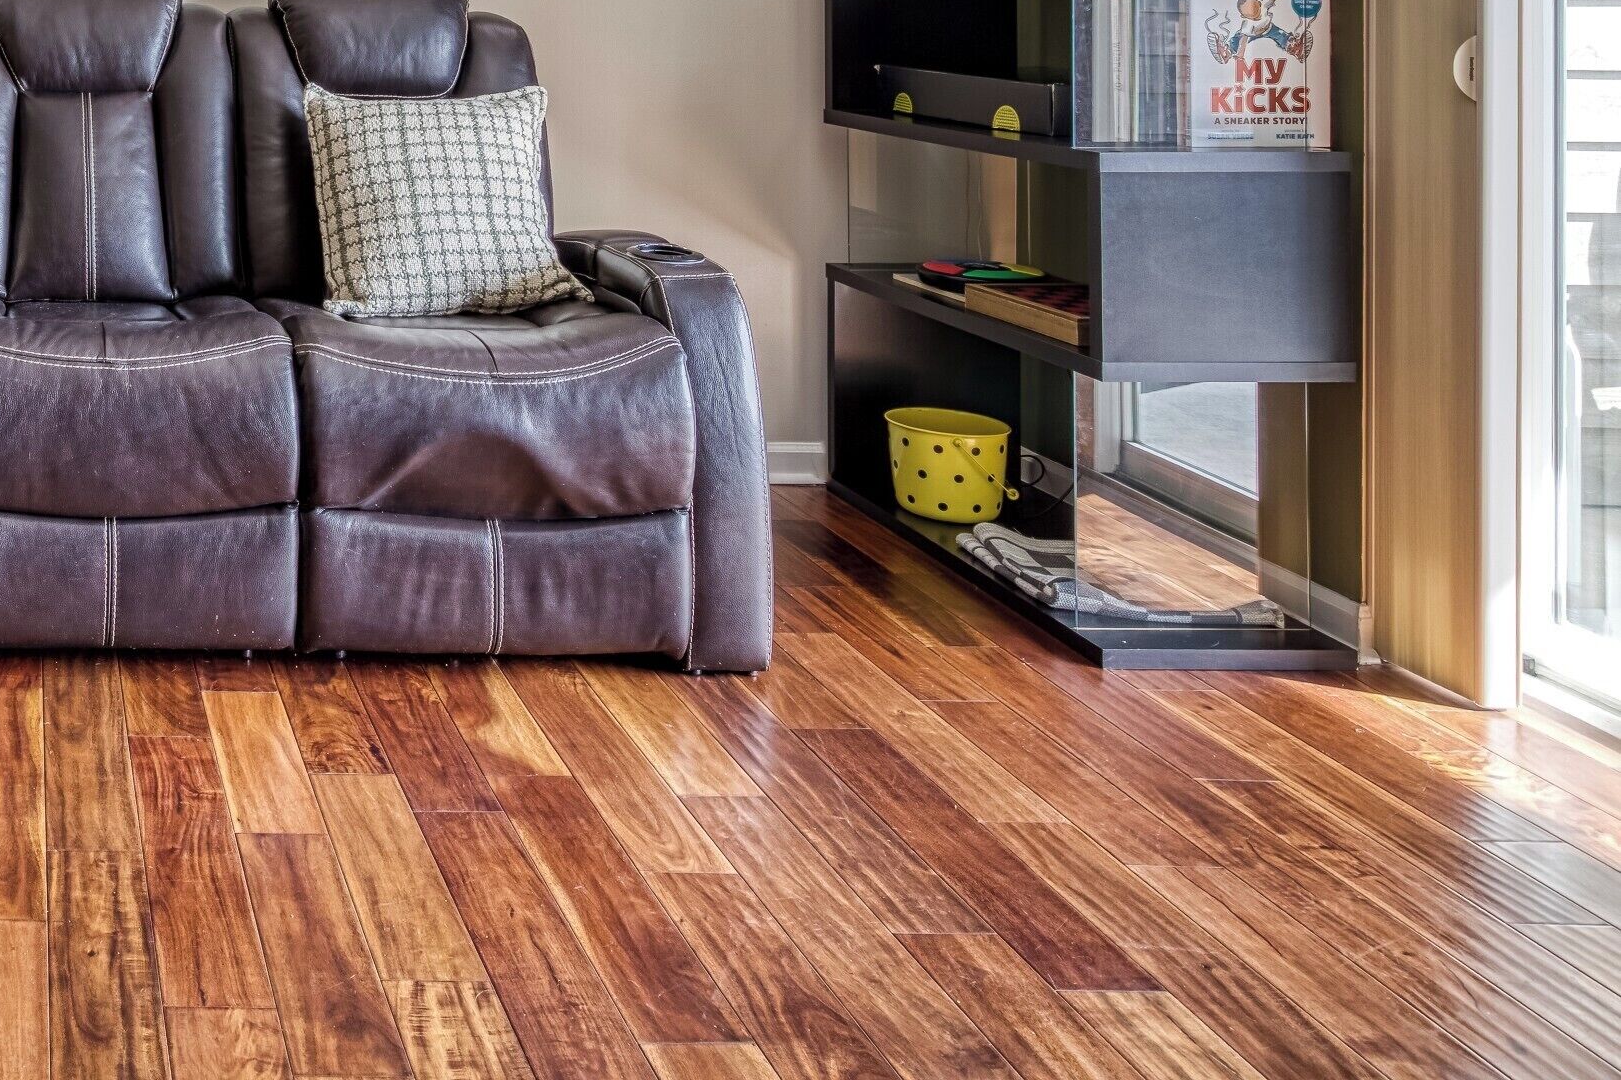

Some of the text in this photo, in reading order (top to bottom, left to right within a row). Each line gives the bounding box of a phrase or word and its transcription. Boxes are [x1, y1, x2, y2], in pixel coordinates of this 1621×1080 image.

[1214, 117, 1306, 125] A SNEAKER STORY
